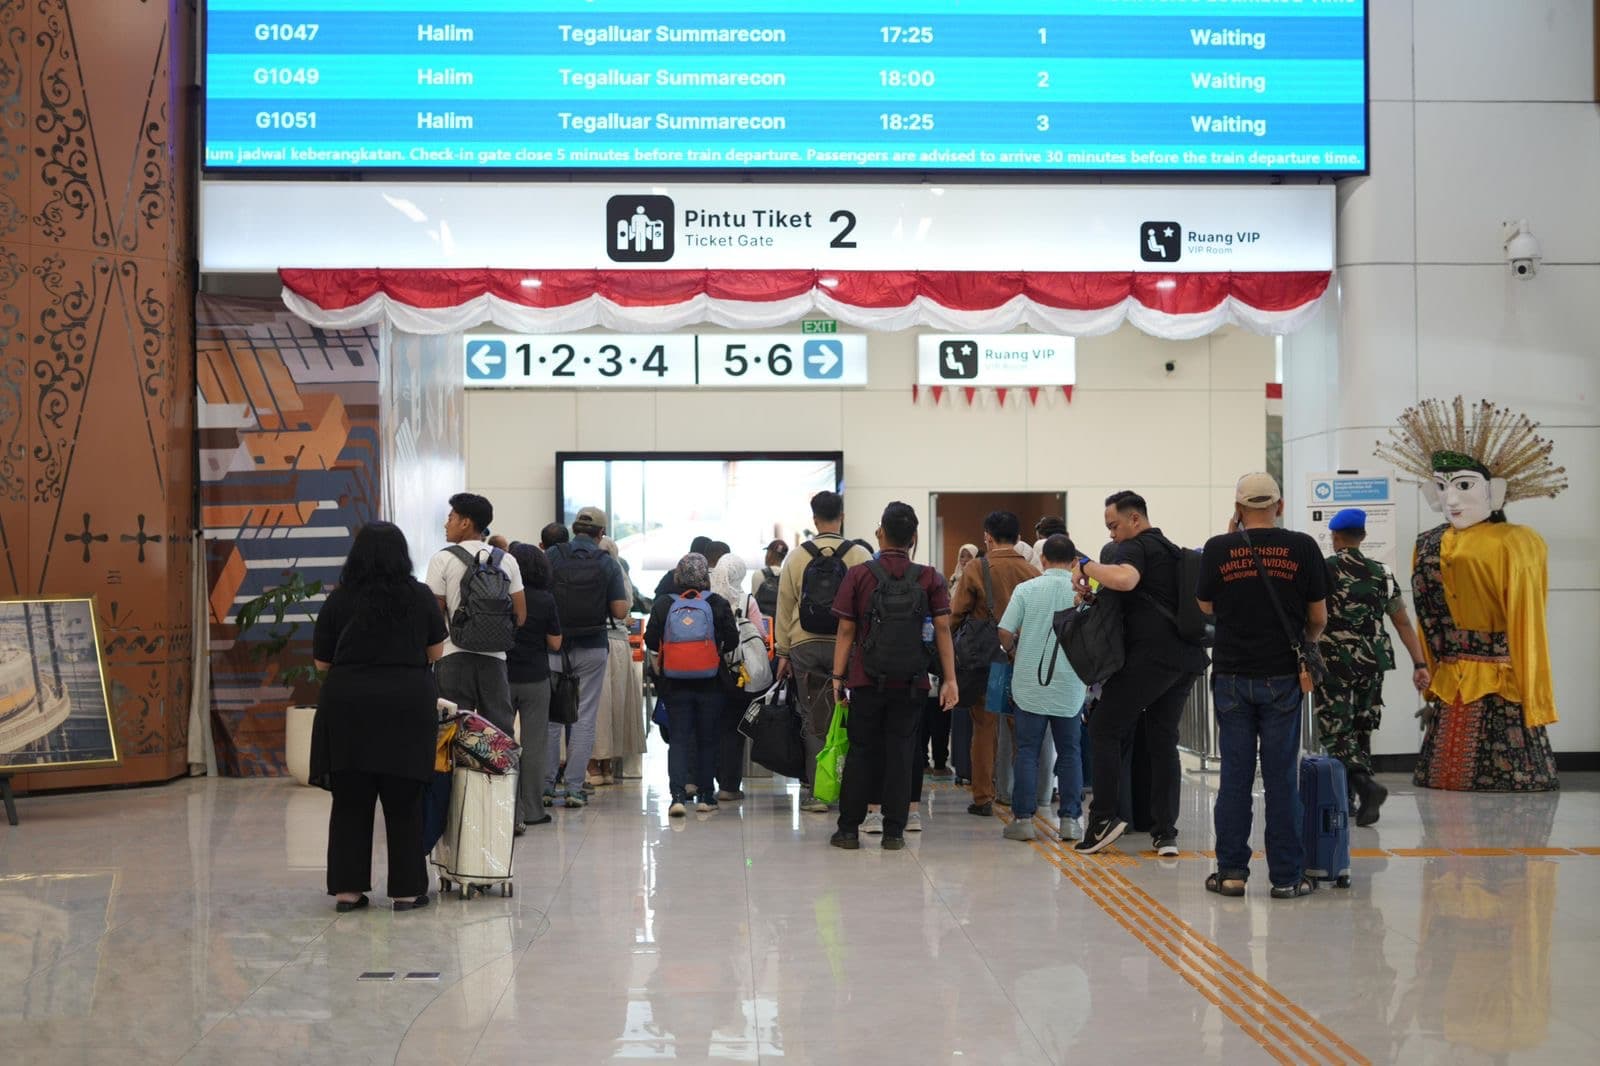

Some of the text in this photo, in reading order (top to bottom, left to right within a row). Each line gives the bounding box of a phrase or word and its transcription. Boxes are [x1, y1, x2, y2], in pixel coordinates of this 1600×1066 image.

[254, 23, 1267, 50] G1047 Halim Tegalluar Summarecon 17:25 1 Waiting
[253, 67, 1267, 94] G1049 Halim Tegalluar Summarecon 18:00 2 Waiting
[255, 111, 1267, 137] G1051 Halim Tegalluar Summarecon 18:25 3 Waiting
[236, 147, 287, 164] jadwal
[290, 147, 405, 165] keberangkatan.
[409, 147, 474, 161] Check-in
[477, 148, 513, 164] gate
[514, 147, 554, 161] close
[556, 148, 567, 161] 5
[569, 147, 631, 161] minutes
[634, 147, 684, 161] before
[686, 148, 722, 161] train
[724, 148, 803, 165] departure.
[805, 148, 889, 165] Passengers
[891, 151, 917, 162] are
[919, 149, 976, 163] advised
[979, 150, 996, 163] to
[999, 150, 1042, 163] arrive
[1045, 150, 1064, 163] 30
[1066, 150, 1127, 164] minutes
[1130, 150, 1180, 164] before
[1182, 150, 1208, 164] the
[1210, 151, 1245, 164] train
[1247, 151, 1321, 168] departure
[1324, 151, 1361, 165] time.
[684, 209, 812, 228] Pintu Tiket
[829, 209, 857, 249] 2
[1188, 231, 1261, 245] Ruang VIP
[684, 234, 774, 247] Ticket Gate
[1188, 245, 1233, 254] VIP Room
[804, 321, 835, 333] EXIT
[985, 348, 1055, 361] Ruang VIP
